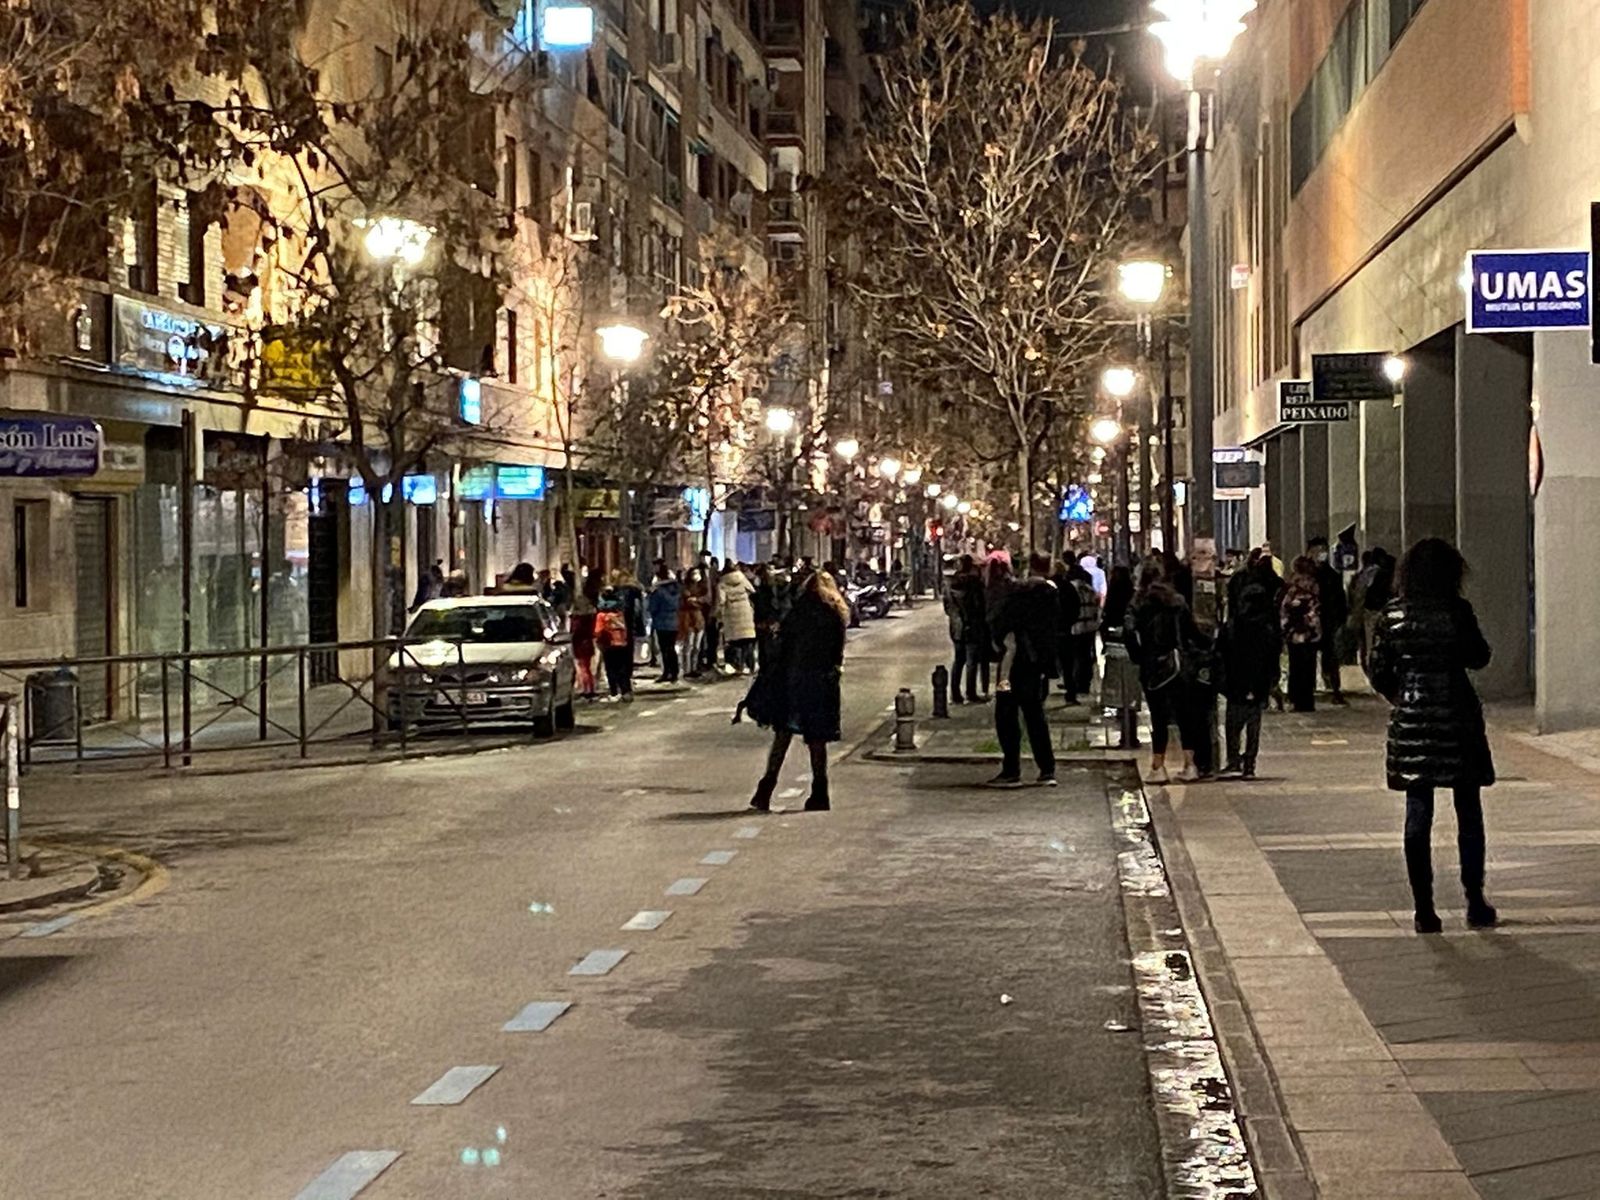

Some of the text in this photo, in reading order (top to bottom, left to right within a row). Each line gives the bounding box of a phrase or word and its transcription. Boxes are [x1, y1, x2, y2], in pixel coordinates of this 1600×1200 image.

[1480, 270, 1586, 300] UMAS
[1522, 301, 1535, 311] DE
[42, 423, 98, 450] Luis
